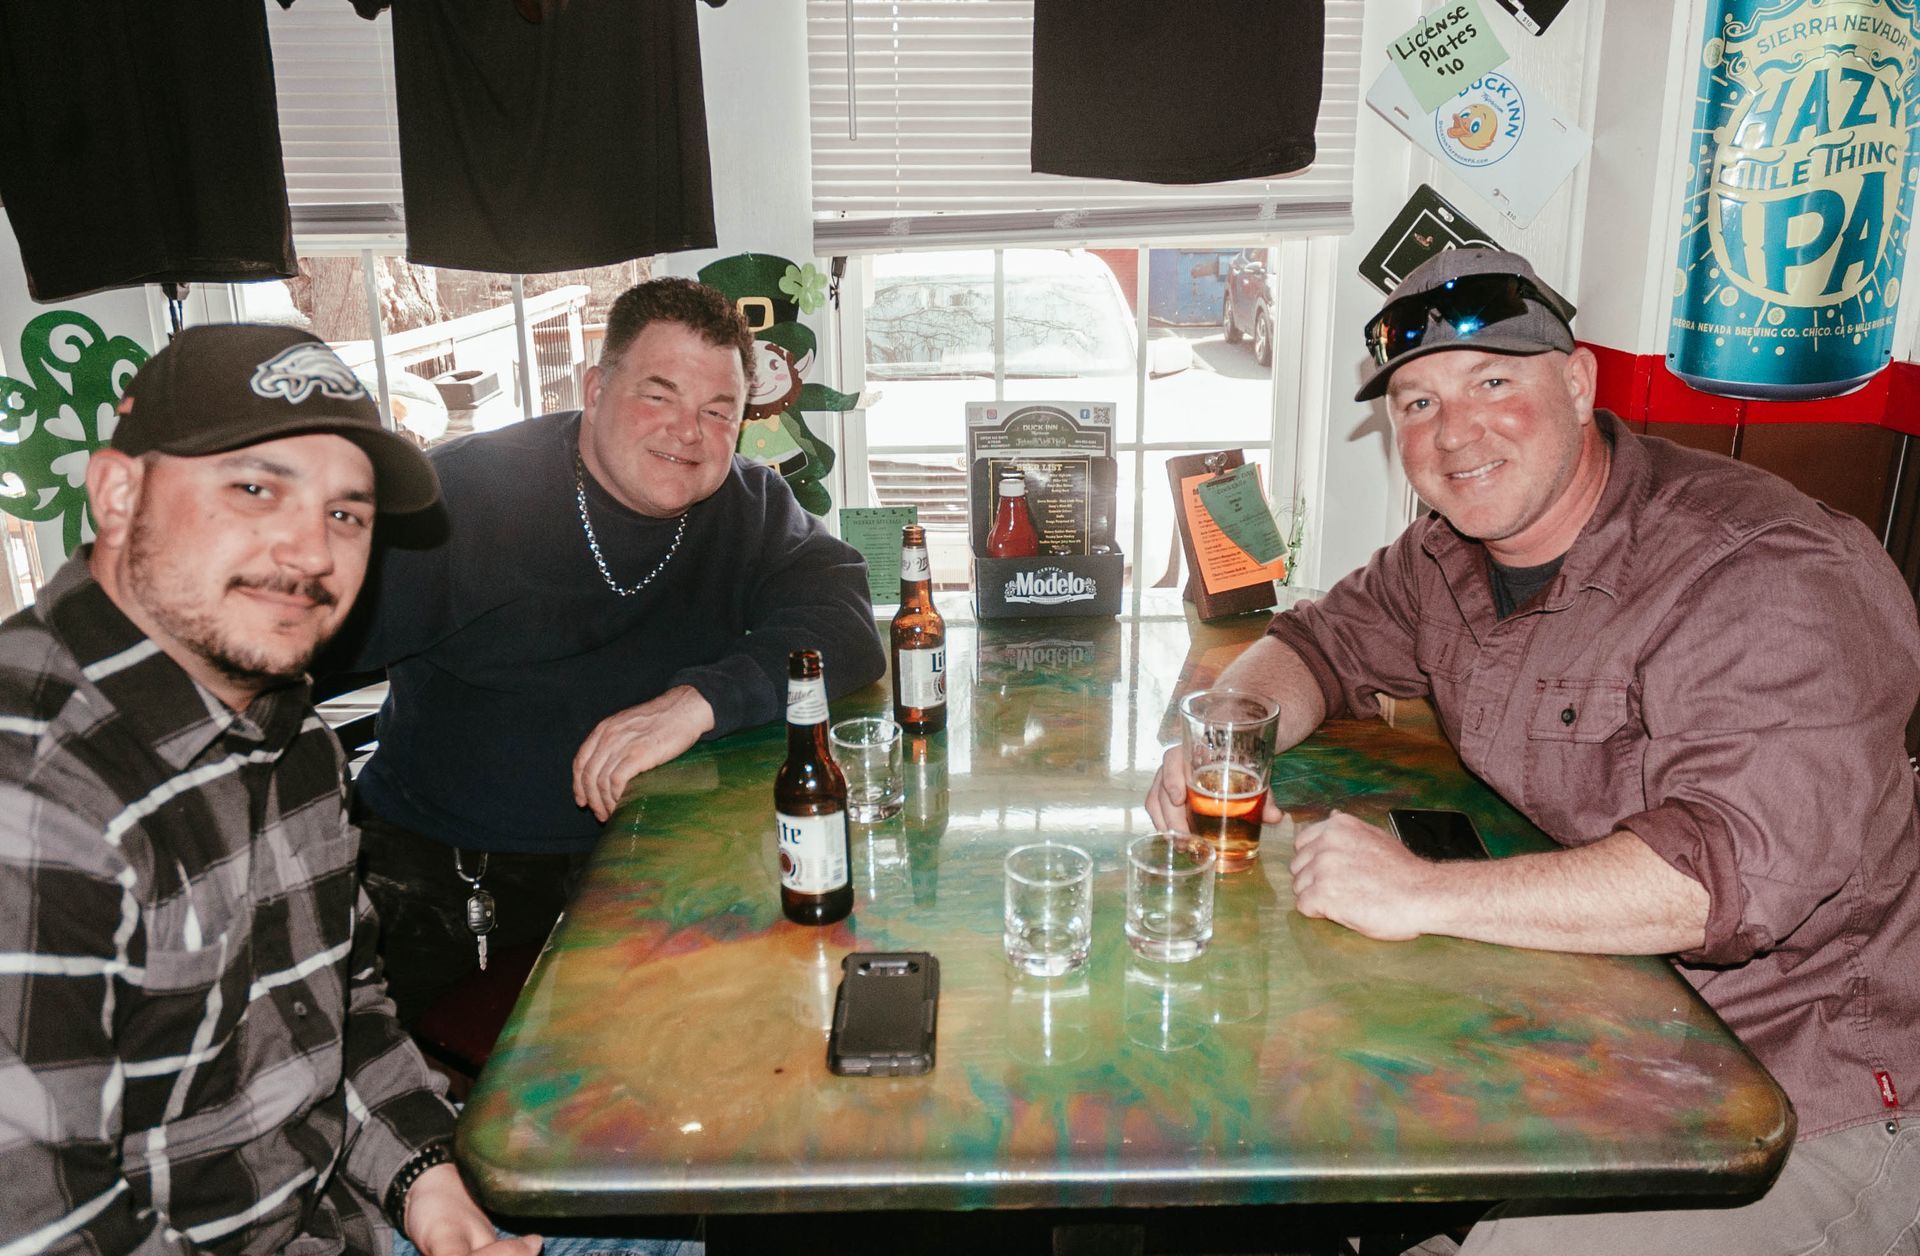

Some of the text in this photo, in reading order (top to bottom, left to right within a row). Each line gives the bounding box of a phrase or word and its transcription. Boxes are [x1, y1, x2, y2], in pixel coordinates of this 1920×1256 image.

[1395, 6, 1469, 60] License
[1522, 17, 1533, 27] $10
[1757, 15, 1909, 54] SIERRA NEVADA
[1419, 24, 1477, 68] Plates
[1437, 58, 1464, 76] $10
[1504, 99, 1521, 138] INN
[1730, 67, 1902, 149] HAZY
[1807, 131, 1897, 178] THING
[1717, 171, 1888, 297] IPA
[1697, 322, 1732, 335] NEVADA
[1735, 326, 1778, 337] BREWING
[1045, 423, 1058, 431] INN
[1016, 571, 1085, 596] Modelo
[1037, 566, 1063, 574] CERVEZA
[777, 819, 801, 844] ite
